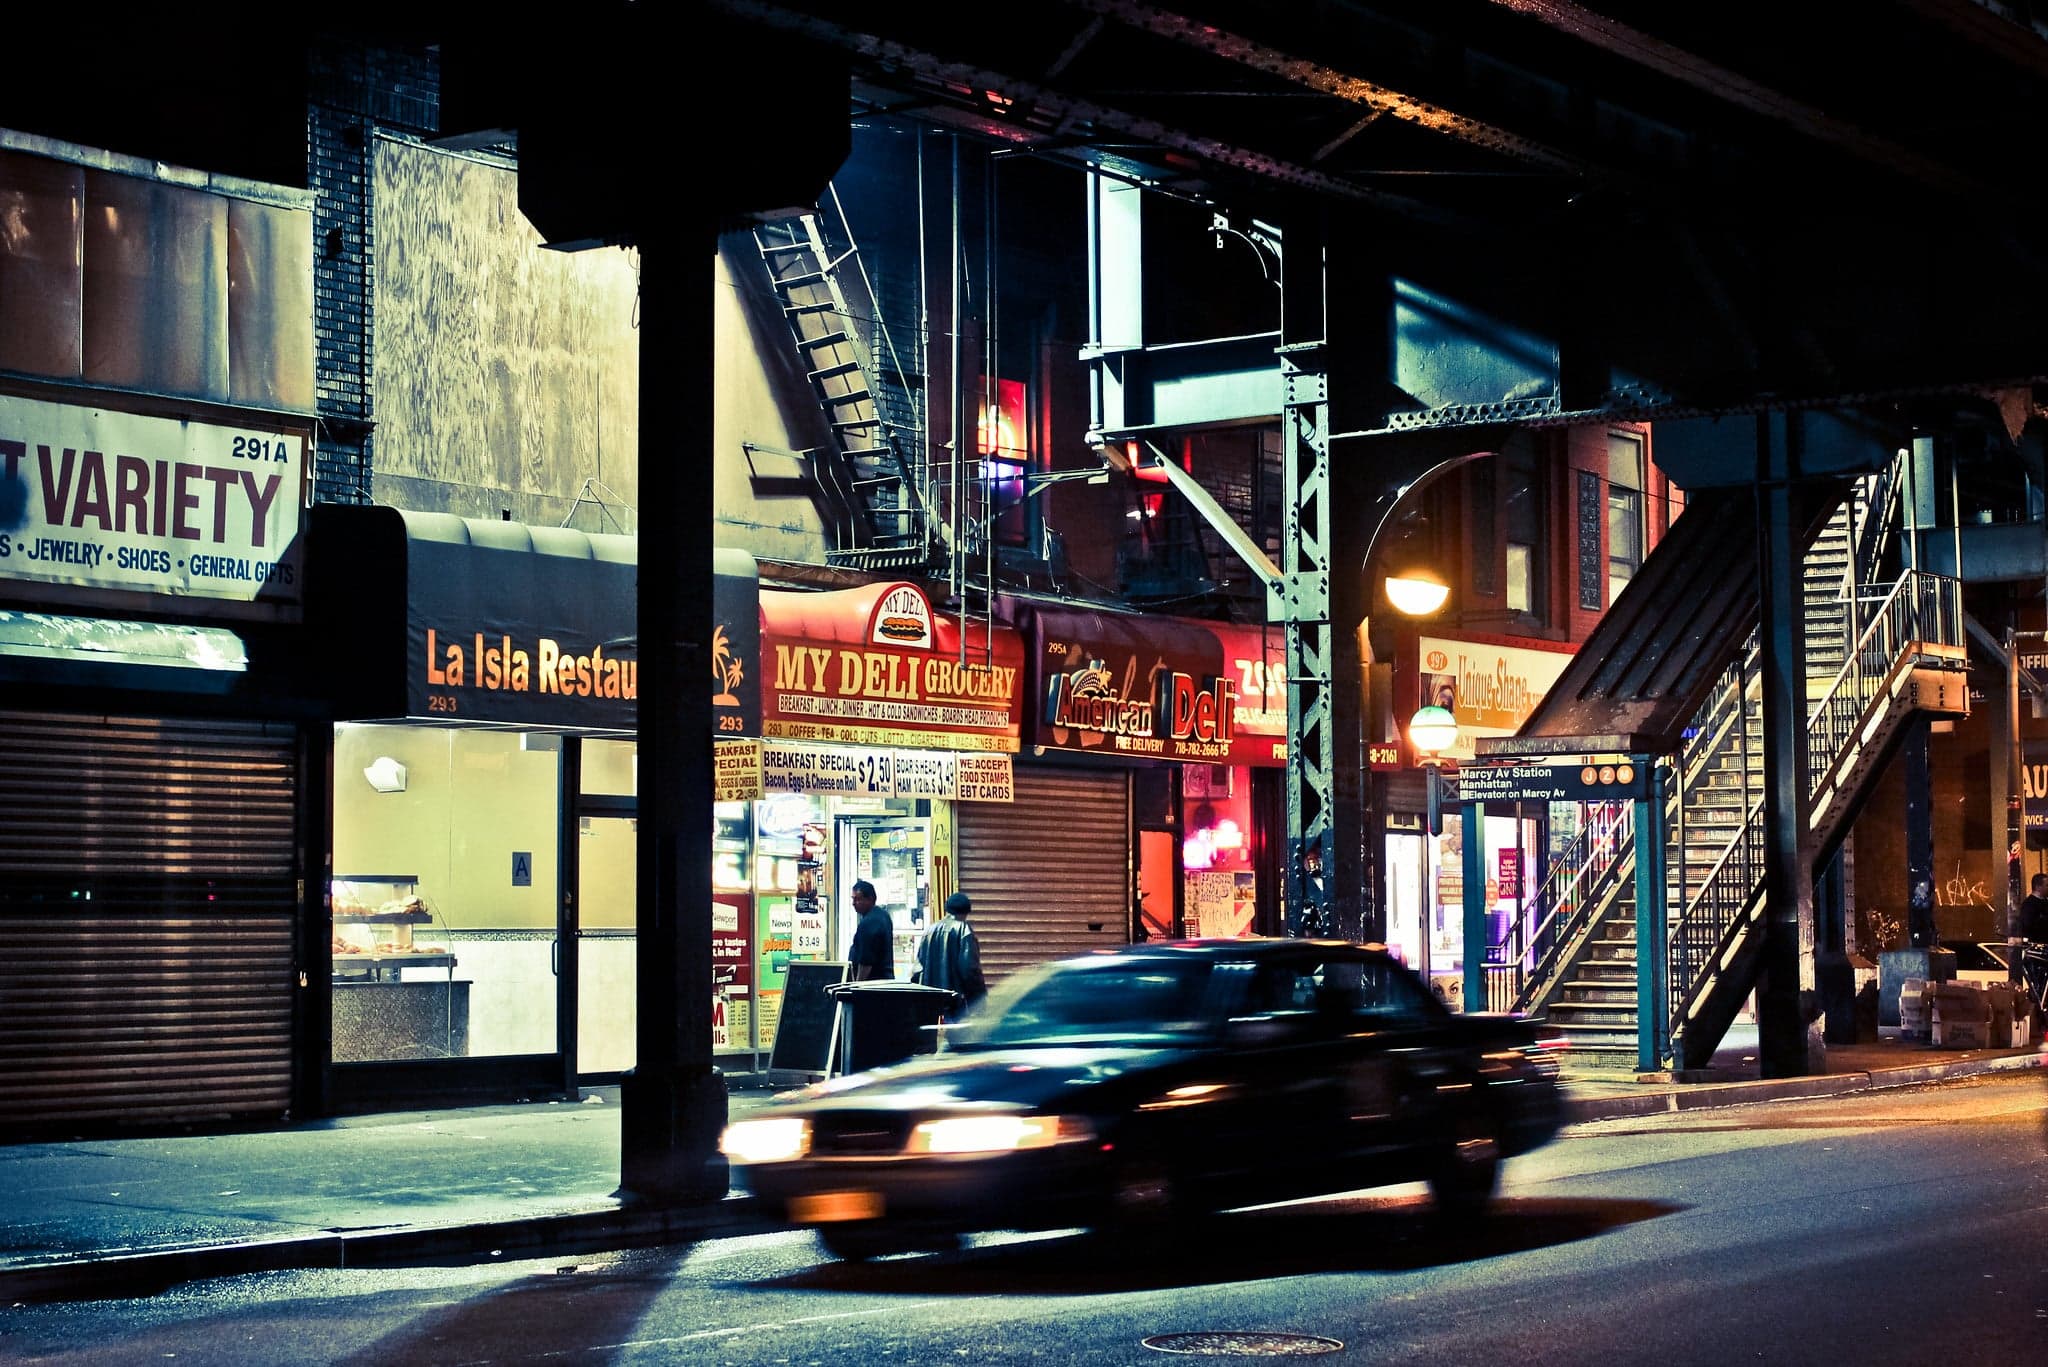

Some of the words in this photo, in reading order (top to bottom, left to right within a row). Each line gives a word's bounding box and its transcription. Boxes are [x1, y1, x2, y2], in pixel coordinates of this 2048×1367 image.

[232, 436, 288, 463] 291A
[37, 444, 282, 548] VARIETY
[28, 538, 104, 568] JEWELRY
[117, 547, 171, 573] SHOES
[190, 555, 252, 581] GENERAL
[255, 561, 294, 585] GIFTS
[885, 592, 900, 613] MY
[902, 591, 924, 616] DELI
[1048, 642, 1067, 655] 295A
[427, 629, 464, 687] La
[475, 632, 529, 692] Isla
[539, 638, 637, 700] Restau
[775, 645, 832, 692] MY
[839, 650, 920, 700] DELI
[925, 658, 1016, 699] GROCERY
[1458, 655, 1493, 720] Unique
[1495, 657, 1528, 724] Shape
[428, 696, 457, 712] 293
[780, 696, 814, 712] BREAKFAST
[819, 698, 838, 715] LUNCH
[843, 700, 864, 716] DINNER
[869, 703, 880, 718] HOT
[887, 704, 901, 720] COLD
[903, 705, 938, 722] SANDWICHES
[964, 710, 978, 724] HEAD
[980, 711, 1008, 726] PRODUCTS
[1055, 672, 1152, 736] American
[1171, 672, 1235, 743] Deli
[719, 716, 744, 732] 293
[768, 723, 782, 736] 293
[789, 725, 815, 738] COFFEE
[822, 727, 834, 738] TEA
[840, 729, 858, 741] COLD
[861, 731, 878, 743] CUTS
[883, 732, 904, 744] LOTTO
[1115, 736, 1131, 750] FREE
[1132, 738, 1164, 753] DELIVERY
[764, 751, 816, 769] BREAKFAST
[820, 753, 856, 772] SPECIAL
[960, 759, 973, 769] WE
[975, 760, 1008, 771] ACCEPT
[764, 771, 788, 791] Bacon,
[789, 772, 805, 793] Eggs
[805, 774, 811, 789] &
[812, 774, 835, 790] Cheese
[836, 778, 844, 790] on
[845, 775, 857, 791] Roll
[960, 771, 978, 783] FOOD
[980, 772, 1009, 784] STAMPS
[1459, 769, 1492, 780] Marcy
[1495, 768, 1510, 778] Av
[1512, 767, 1552, 778] Station
[897, 779, 911, 793] HAM
[960, 785, 978, 798] EBT
[980, 786, 1010, 799] CARDS
[1459, 779, 1512, 789] Manhattan
[1468, 790, 1506, 799] Elevator
[1508, 791, 1519, 799] on
[1522, 790, 1551, 800] Marcy
[1553, 789, 1565, 798] Av
[514, 856, 529, 877] A
[800, 920, 821, 929] MILK
[798, 937, 820, 947] $3.49
